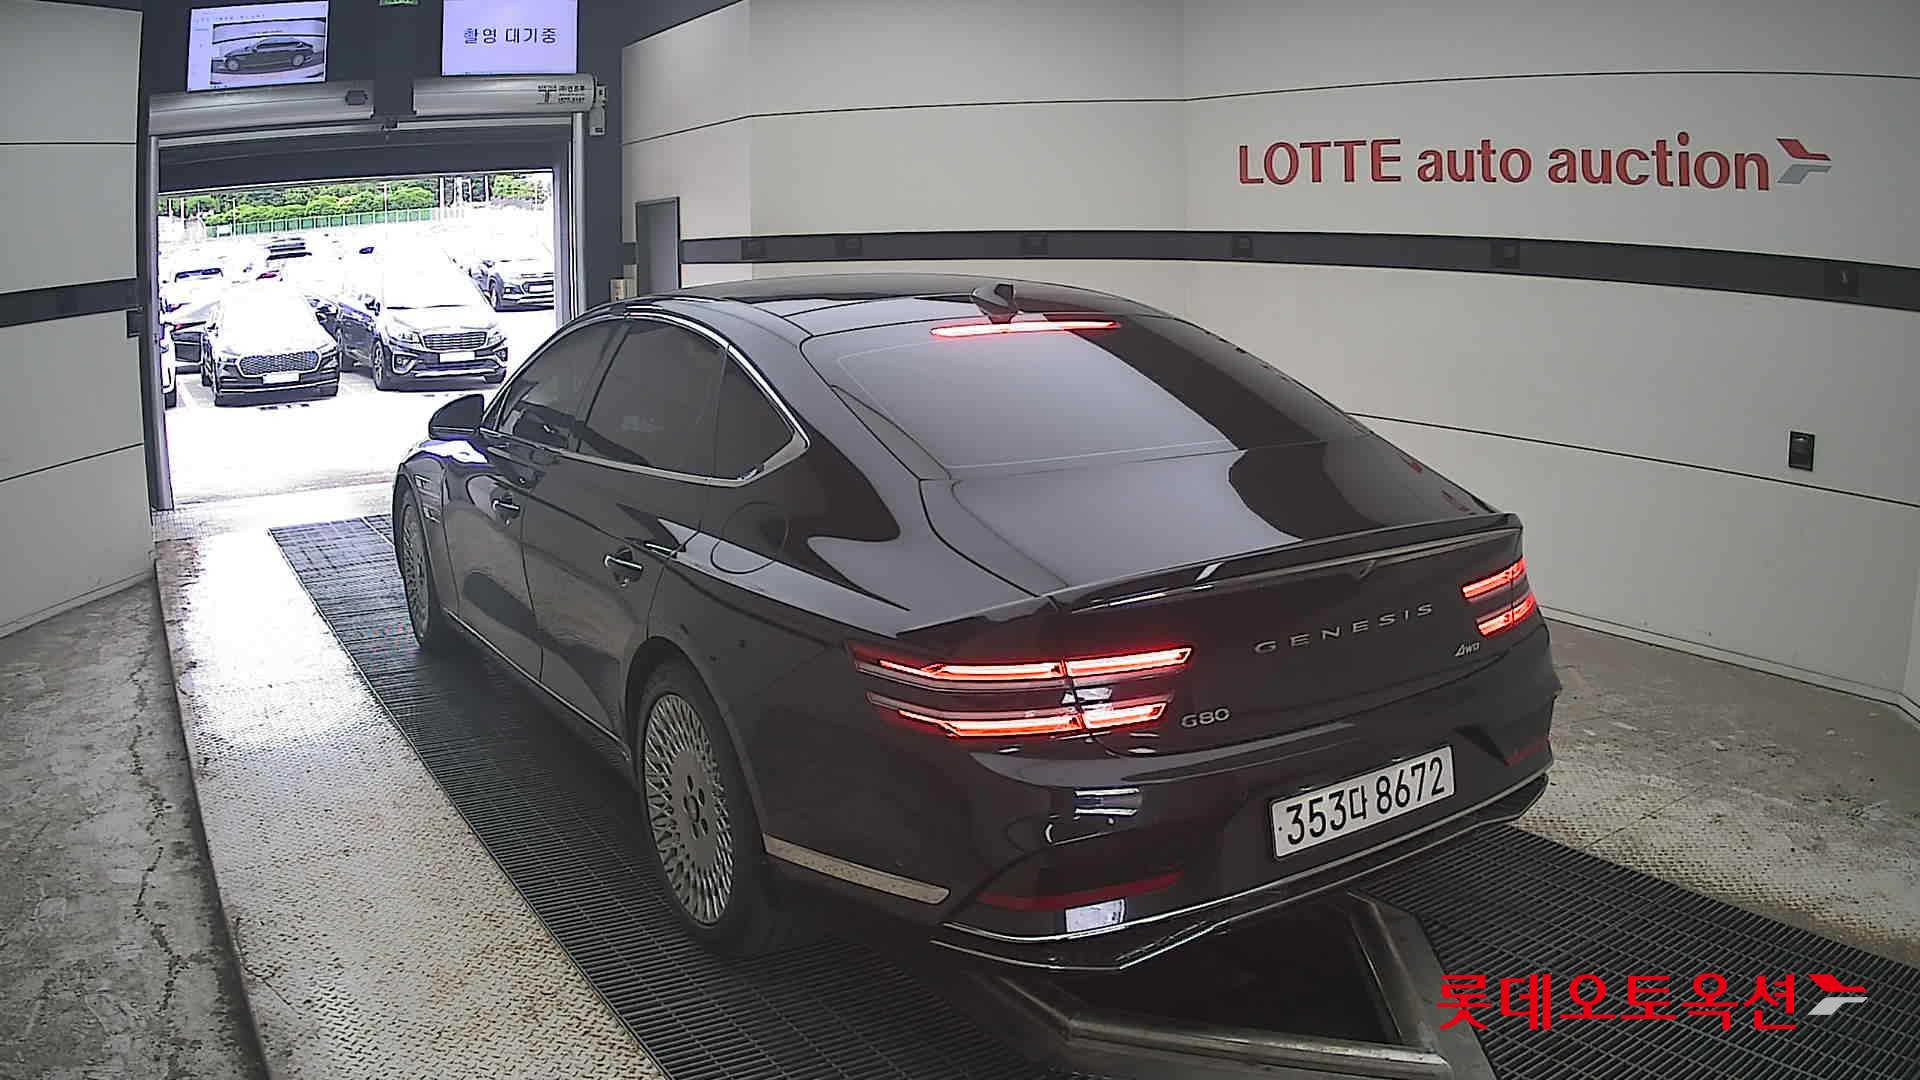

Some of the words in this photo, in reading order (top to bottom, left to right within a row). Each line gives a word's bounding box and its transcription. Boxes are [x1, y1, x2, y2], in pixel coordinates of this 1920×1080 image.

[505, 27, 557, 44] 대기중
[1238, 138, 1402, 185] LOTTE
[1417, 139, 1532, 184] auto
[1547, 131, 1769, 191] auction
[1255, 604, 1432, 653] GENESIS
[1181, 708, 1230, 728] G80
[1286, 784, 1368, 845] 353다
[1375, 756, 1445, 815] 8672
